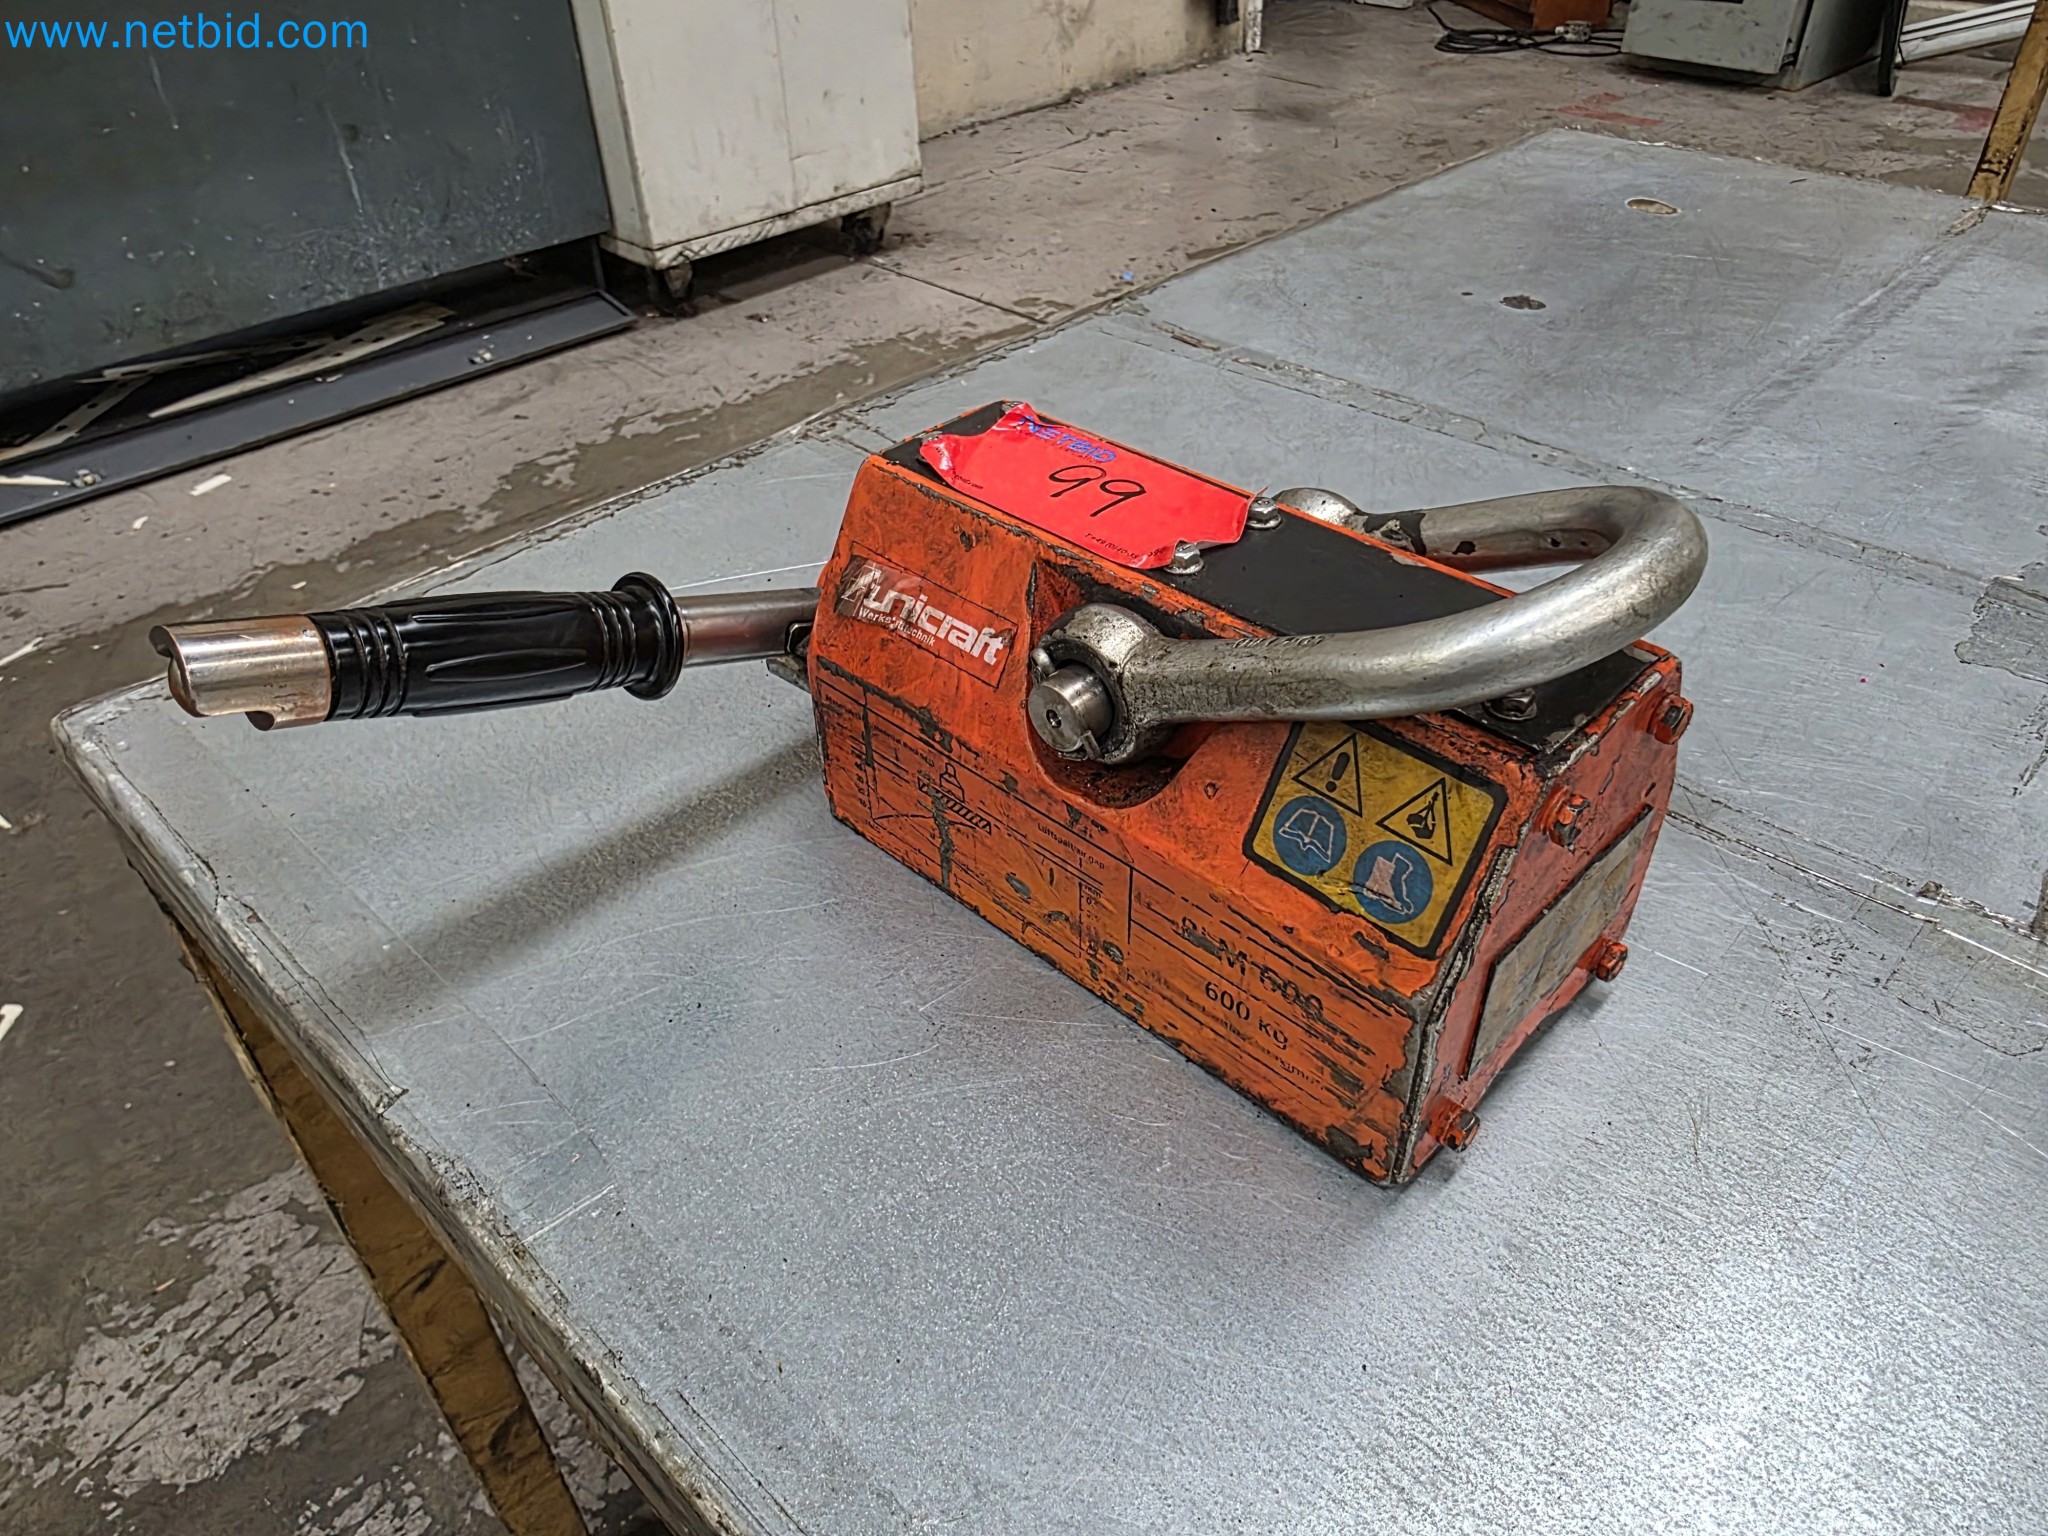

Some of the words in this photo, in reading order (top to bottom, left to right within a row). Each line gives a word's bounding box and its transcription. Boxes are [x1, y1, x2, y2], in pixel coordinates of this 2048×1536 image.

[1018, 415, 1117, 463] NETBID
[1048, 465, 1147, 517] 99
[1205, 981, 1251, 1021] 600
